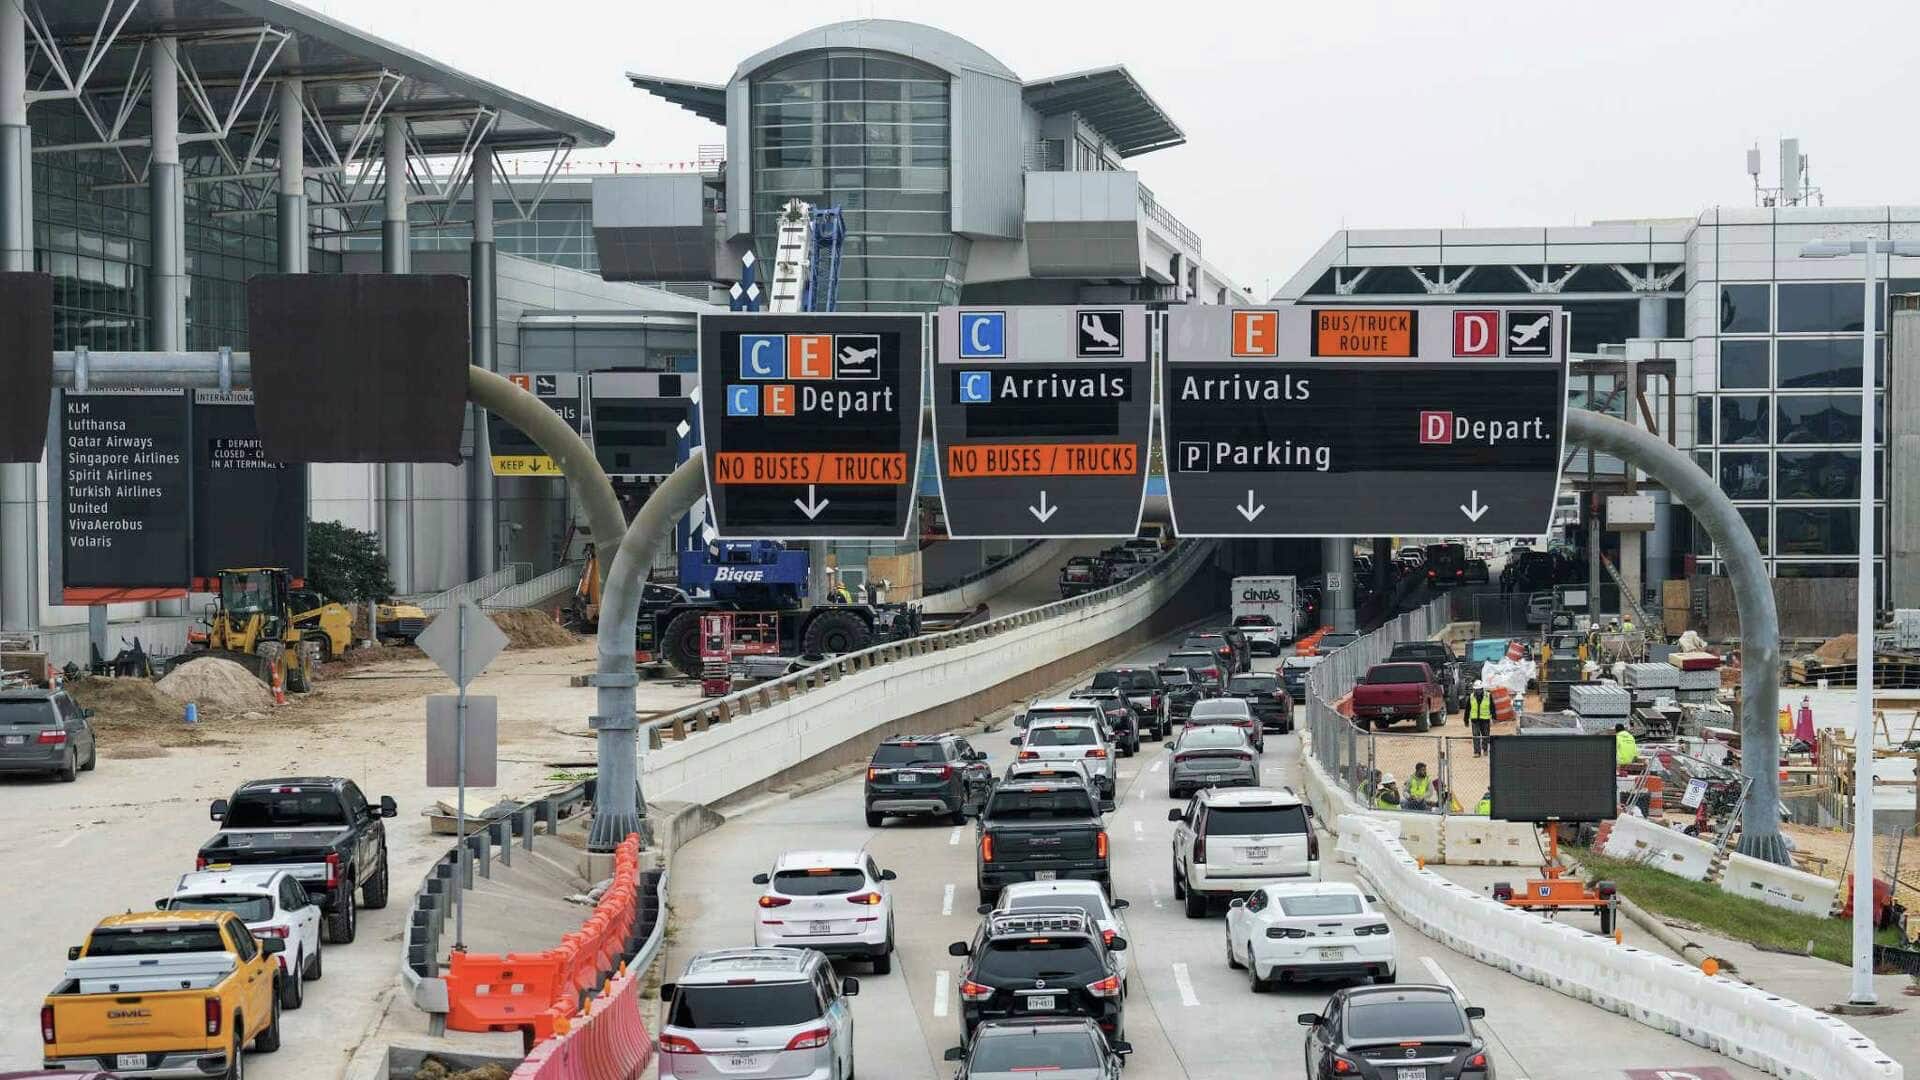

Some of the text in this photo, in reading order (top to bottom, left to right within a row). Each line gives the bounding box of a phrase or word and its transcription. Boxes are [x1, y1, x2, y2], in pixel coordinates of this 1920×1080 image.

[1320, 315, 1408, 332] BUS/TRUCK
[971, 317, 991, 352] C
[1246, 314, 1264, 353] E
[1463, 315, 1489, 353] D
[1339, 335, 1388, 352] ROUTE
[751, 337, 820, 376] C E
[966, 372, 1125, 400] C Arrivals
[1181, 373, 1311, 400] Arrivals
[68, 402, 90, 414] KLM
[735, 385, 893, 418] C E Depart
[68, 418, 126, 431] Lufthansa
[1427, 415, 1551, 445] D Depart.
[68, 435, 153, 450] Qatar Airways
[68, 451, 180, 466] Singapore Airlines
[214, 449, 245, 459] CLOSED
[952, 446, 1133, 473] NO BUSES / TRUCKS
[1187, 440, 1331, 472] P Parking
[211, 459, 220, 469] IN
[223, 459, 233, 469] AT
[236, 459, 277, 469] TERMINAL
[500, 460, 524, 470] KEEP
[719, 454, 903, 482] NO BUSES / TRUCKS
[68, 468, 153, 483] Spirit Airlines
[68, 484, 162, 498] Turkish Airlines
[69, 501, 108, 514] United
[69, 518, 143, 531] VivaAerobus
[70, 535, 112, 548] Volaris
[1242, 587, 1281, 601] CINTAS
[106, 1008, 153, 1020] GMC
